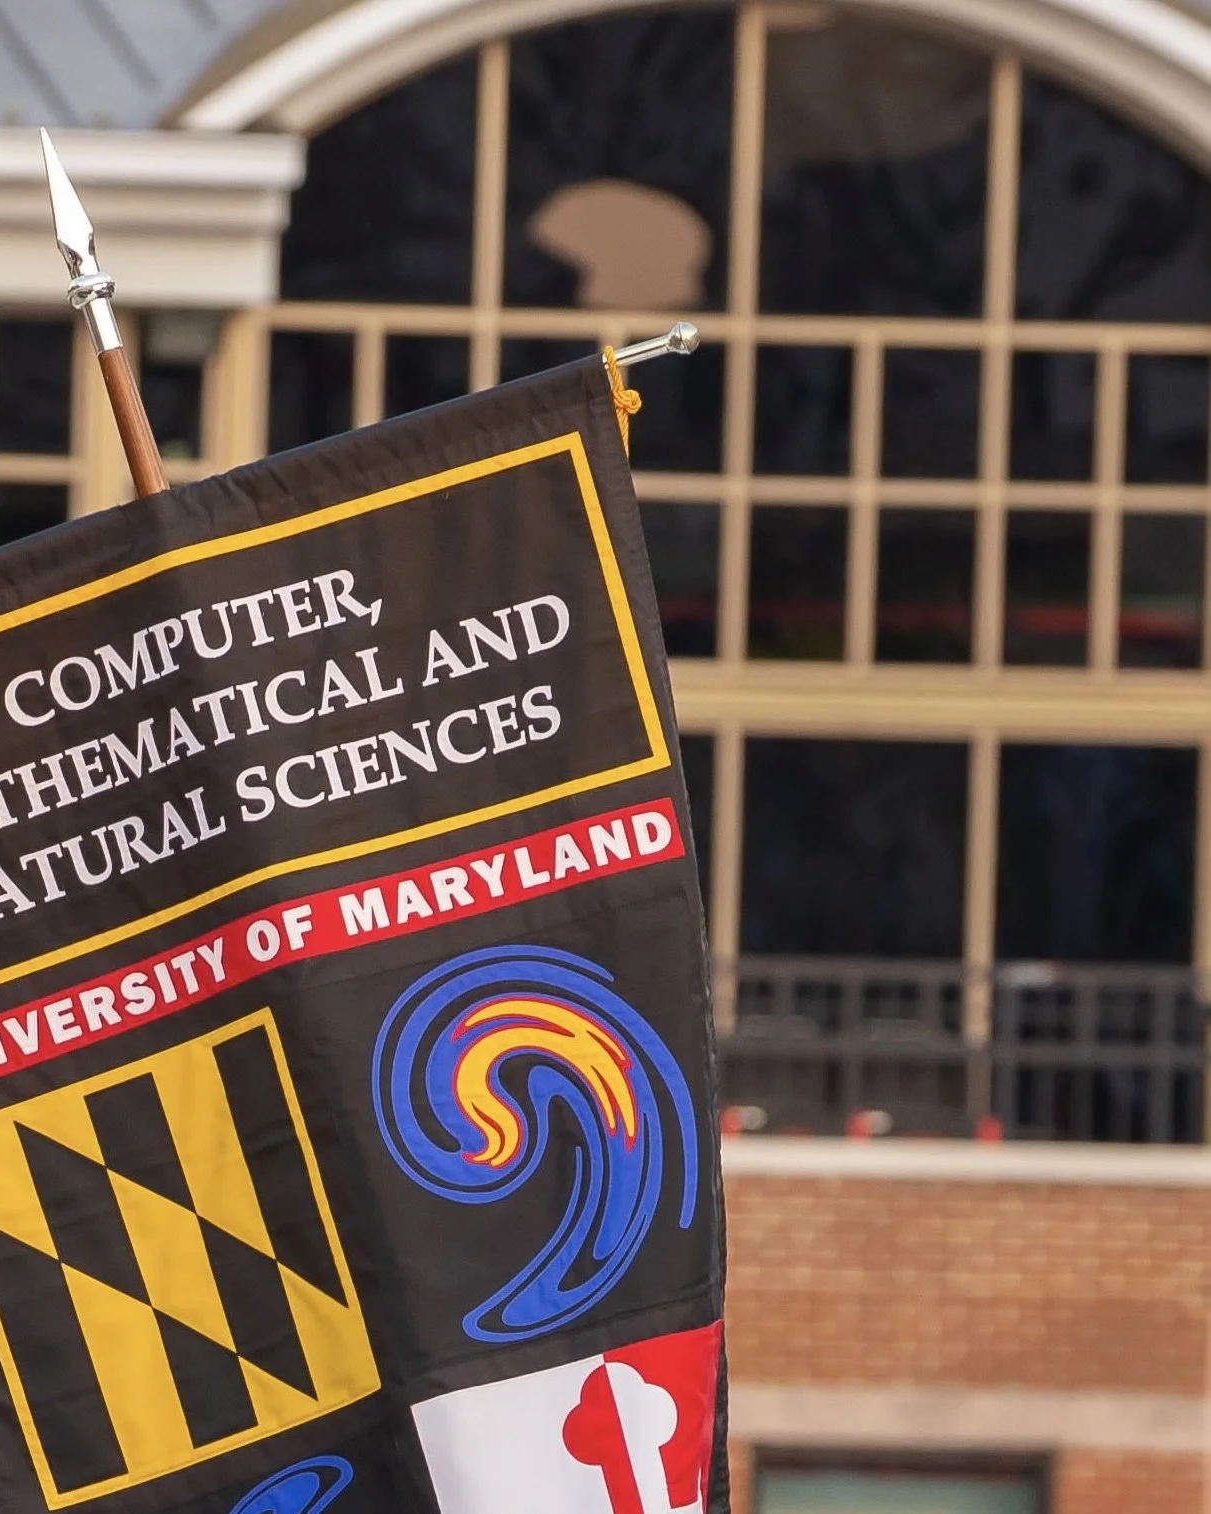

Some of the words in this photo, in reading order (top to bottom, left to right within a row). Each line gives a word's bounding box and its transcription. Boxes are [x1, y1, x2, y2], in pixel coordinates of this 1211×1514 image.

[4, 569, 383, 727] COMPUTER,
[421, 594, 570, 688] AND
[235, 684, 562, 822] SCIENCES
[247, 904, 312, 962] OF
[339, 812, 671, 936] MARYLAND
